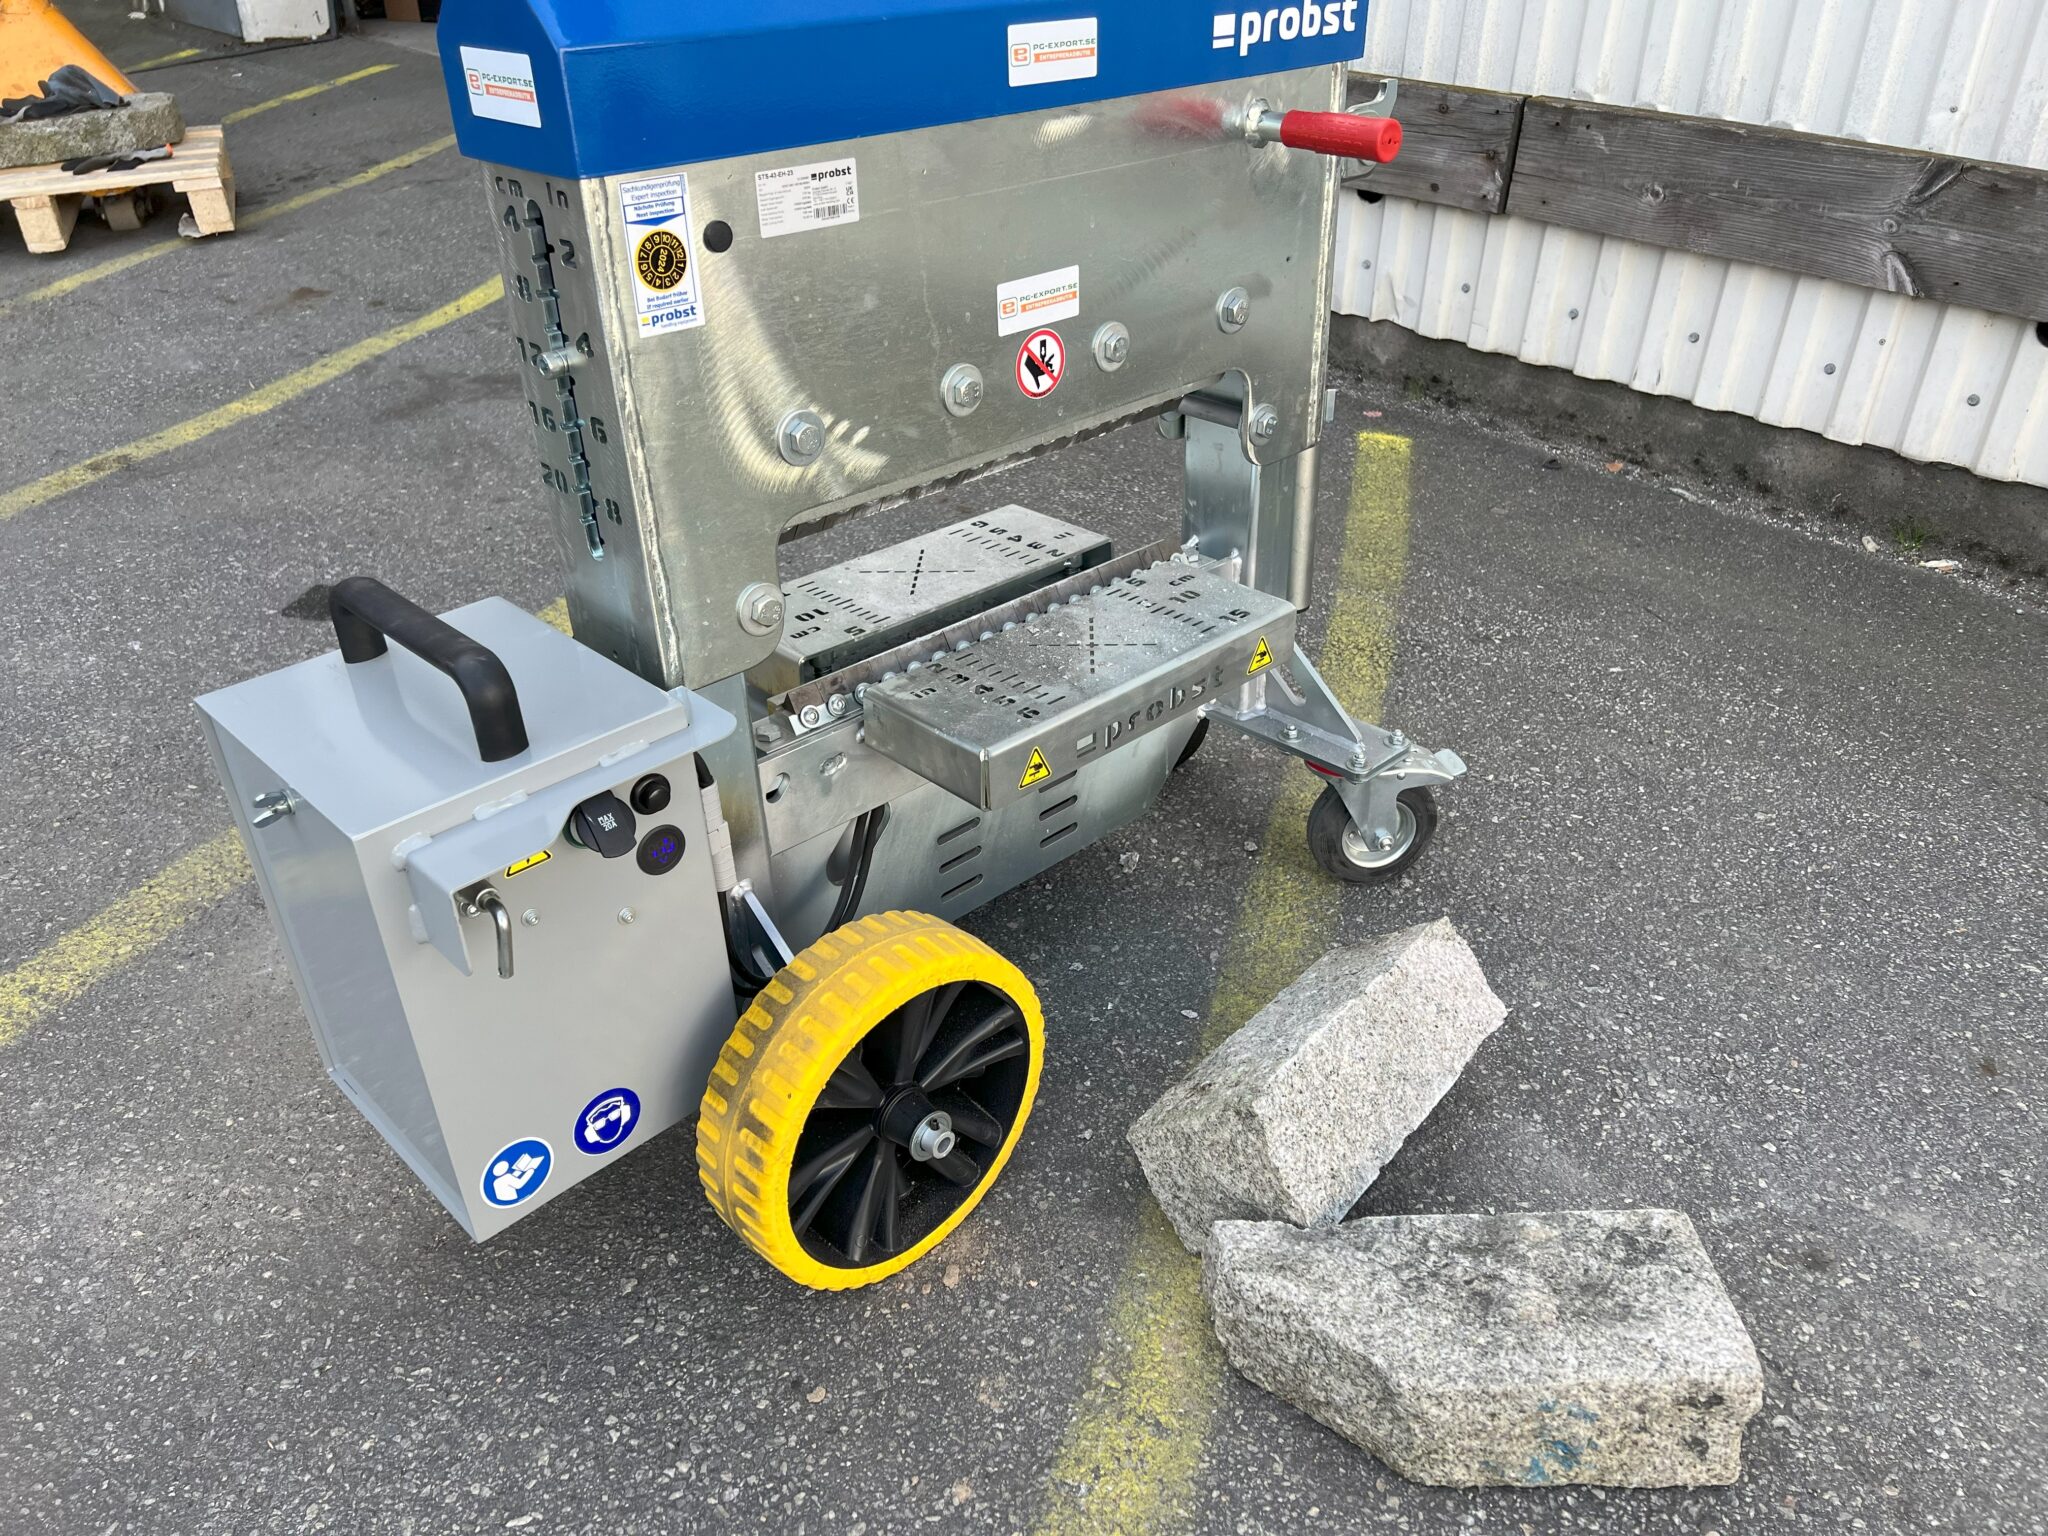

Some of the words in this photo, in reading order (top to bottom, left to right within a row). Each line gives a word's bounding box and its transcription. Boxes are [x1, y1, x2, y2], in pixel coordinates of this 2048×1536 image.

[1239, 0, 1358, 57] probst
[1033, 38, 1096, 51] PG-EXPORT.SE
[482, 73, 534, 88] PG-EXPORT.SE
[818, 165, 852, 182] probst
[495, 176, 523, 198] cm
[631, 193, 649, 201] Expert
[653, 234, 660, 243] 9
[662, 234, 671, 243] 10
[671, 239, 679, 248] 11
[644, 241, 652, 249] 8
[559, 238, 577, 270] 2
[676, 248, 684, 259] 12
[657, 248, 668, 273] 2024
[641, 263, 648, 271] 6
[646, 272, 653, 281] 5
[655, 278, 662, 286] 4
[665, 277, 671, 286] 3
[672, 272, 679, 280] 2
[1020, 282, 1078, 302] PG-EXPORT.SE
[651, 305, 697, 327] probst
[528, 400, 557, 433] 16
[590, 416, 608, 444] 6
[540, 461, 569, 494] 20
[605, 498, 622, 526] 8
[989, 527, 1008, 535] 5
[1026, 541, 1047, 549] 3
[1045, 549, 1066, 557] 2
[1126, 578, 1147, 587] 5
[1168, 574, 1196, 587] cm
[1168, 590, 1201, 603] 10
[794, 608, 830, 622] 10
[1218, 608, 1251, 622] 15
[789, 626, 821, 639] cm
[843, 626, 866, 636] 5
[925, 663, 949, 673] 2
[946, 673, 970, 685] 3
[910, 687, 937, 699] in
[974, 684, 995, 695] 4
[1016, 707, 1041, 719] 6
[1104, 664, 1224, 750] probst
[597, 812, 615, 824] MAX
[602, 821, 618, 832] 20A
